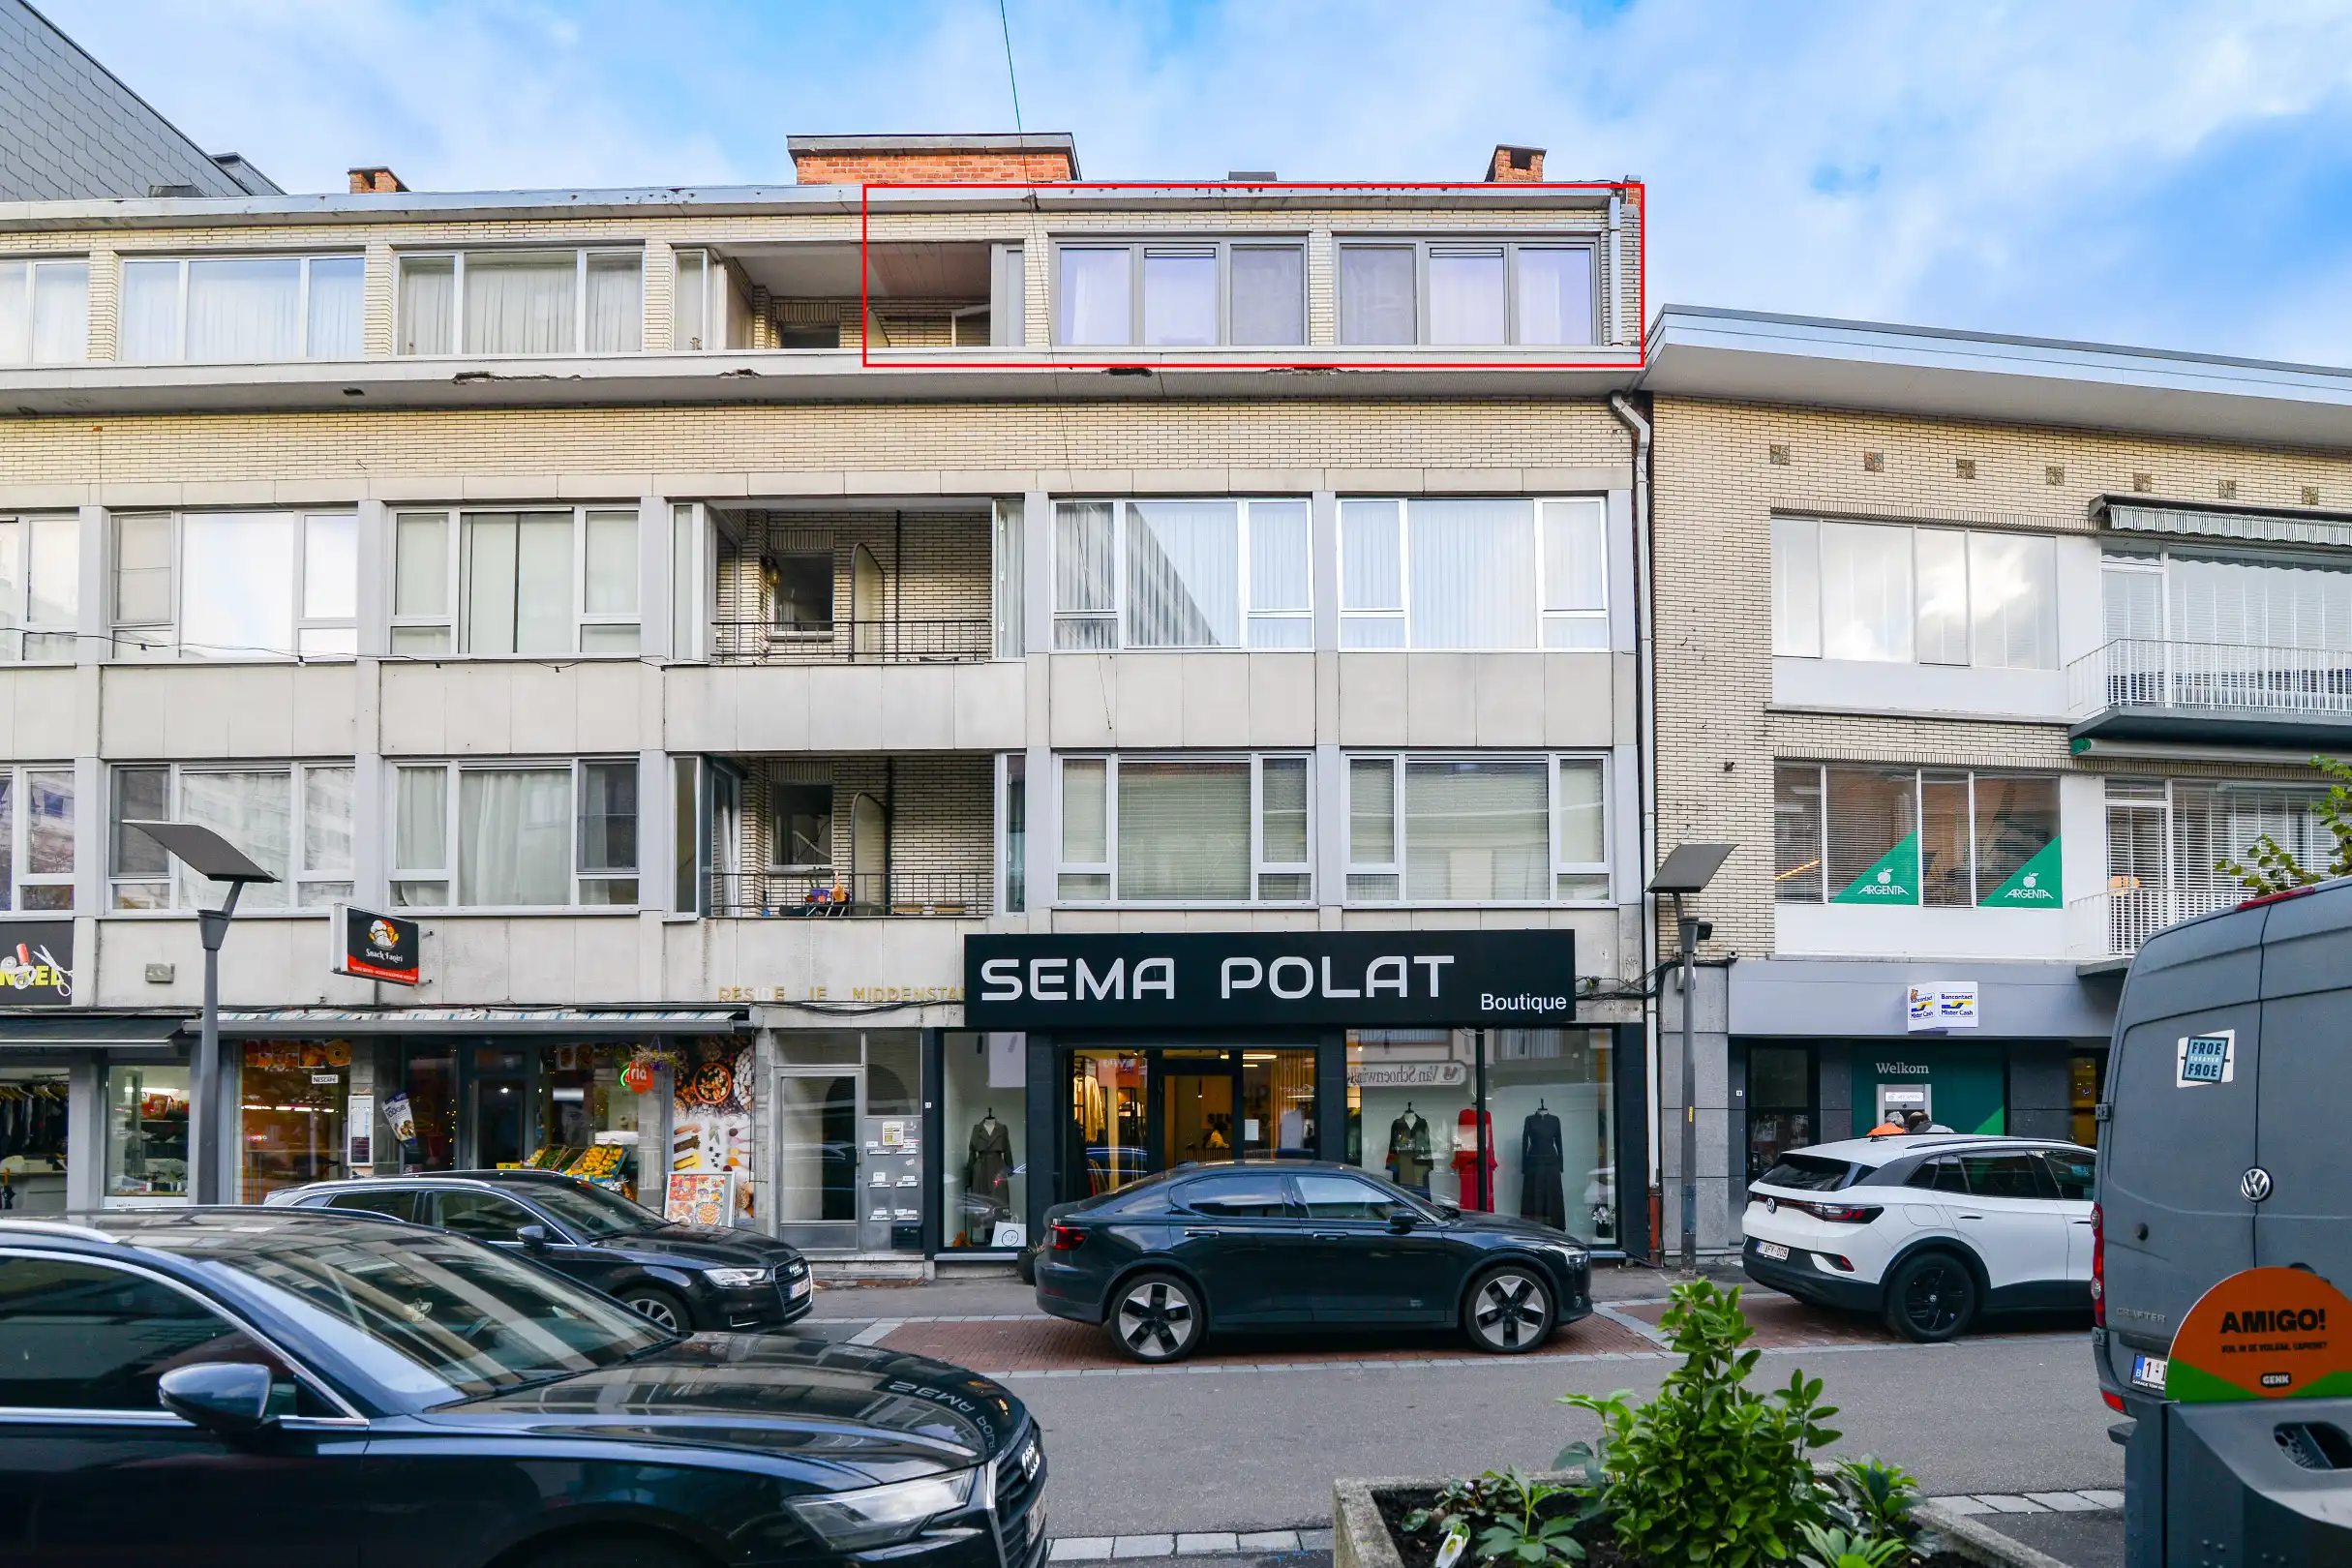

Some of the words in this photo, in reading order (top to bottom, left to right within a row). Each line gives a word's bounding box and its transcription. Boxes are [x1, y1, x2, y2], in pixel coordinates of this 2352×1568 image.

[1857, 885, 1910, 895] ARGENTA
[2004, 889, 2054, 899] ARGENTA
[366, 949, 384, 960] Snack
[980, 957, 1175, 1001] SEMA
[1221, 955, 1455, 999] POLAT
[1480, 993, 1567, 1013] Boutique
[2191, 1041, 2222, 1056] FROE
[1876, 1062, 1930, 1074] Welkom
[2116, 1307, 2167, 1323] CRAFTER
[2220, 1309, 2326, 1334] AMIGO!
[2262, 1374, 2289, 1385] GENK
